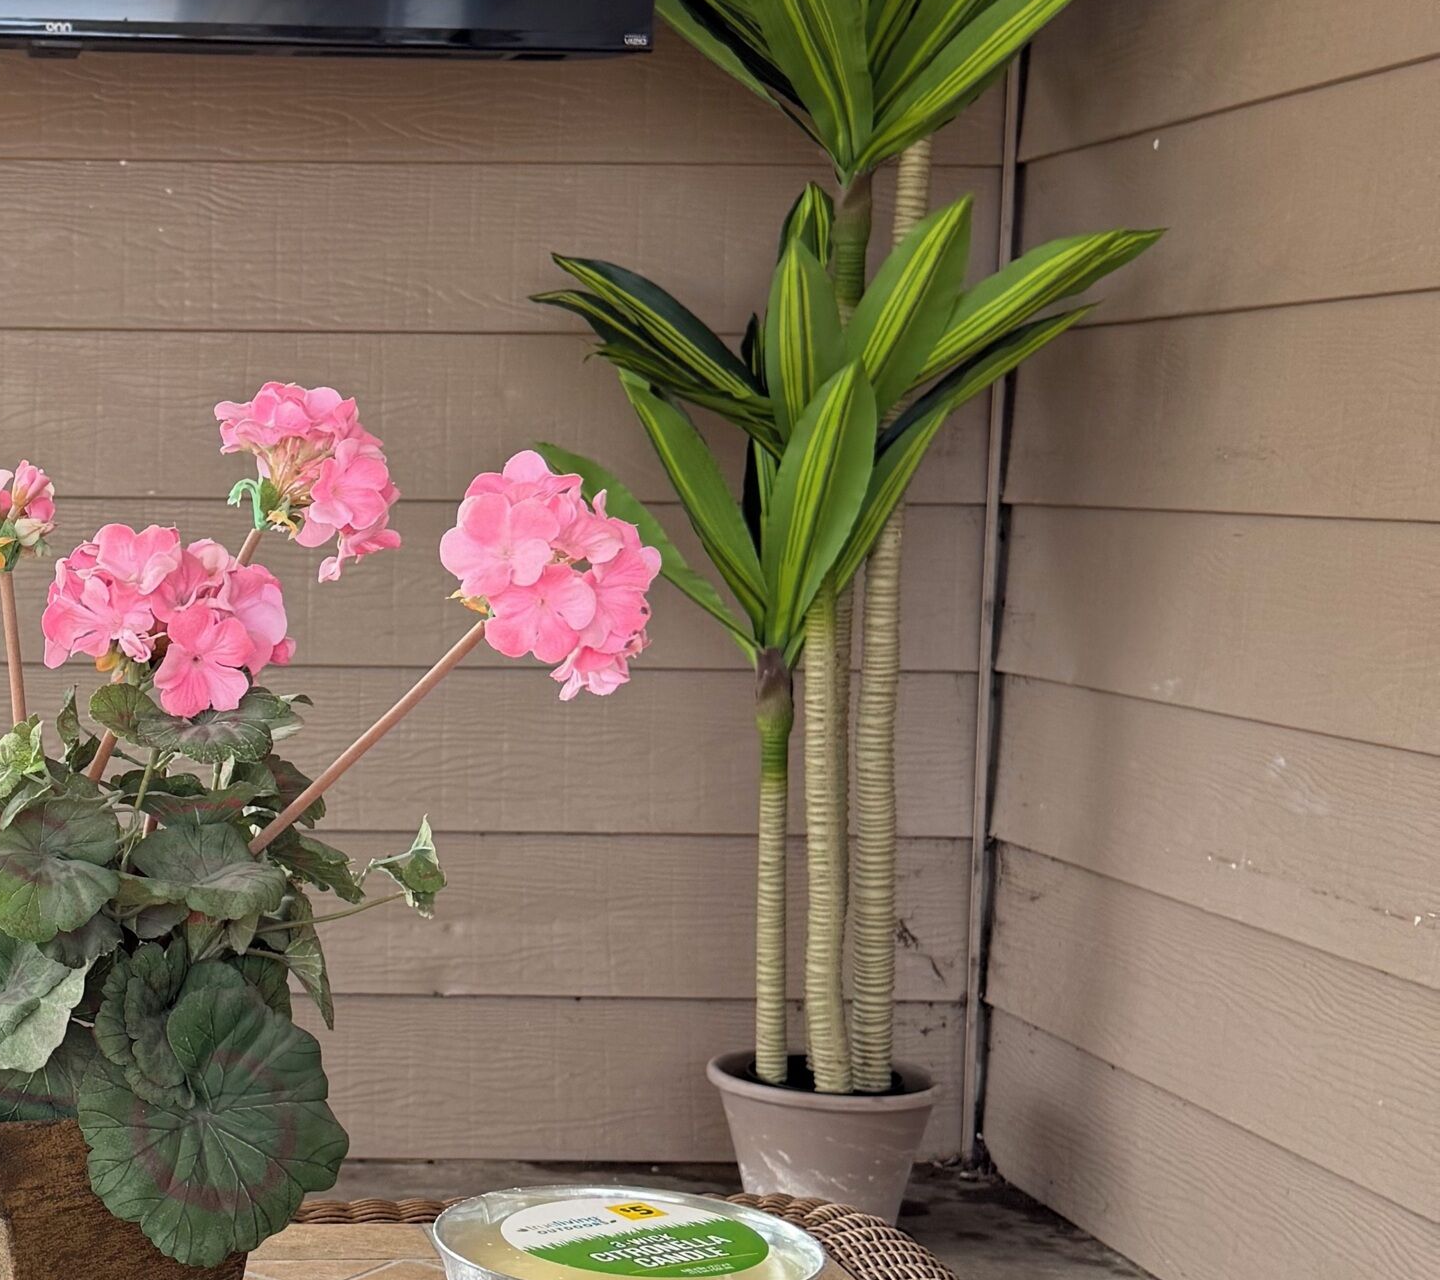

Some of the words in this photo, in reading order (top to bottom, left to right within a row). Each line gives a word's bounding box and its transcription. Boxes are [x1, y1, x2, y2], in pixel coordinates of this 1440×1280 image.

[589, 1235, 733, 1262] CITRONELLA
[609, 1233, 676, 1248] 3-WICK
[633, 1247, 730, 1268] CANDLE
